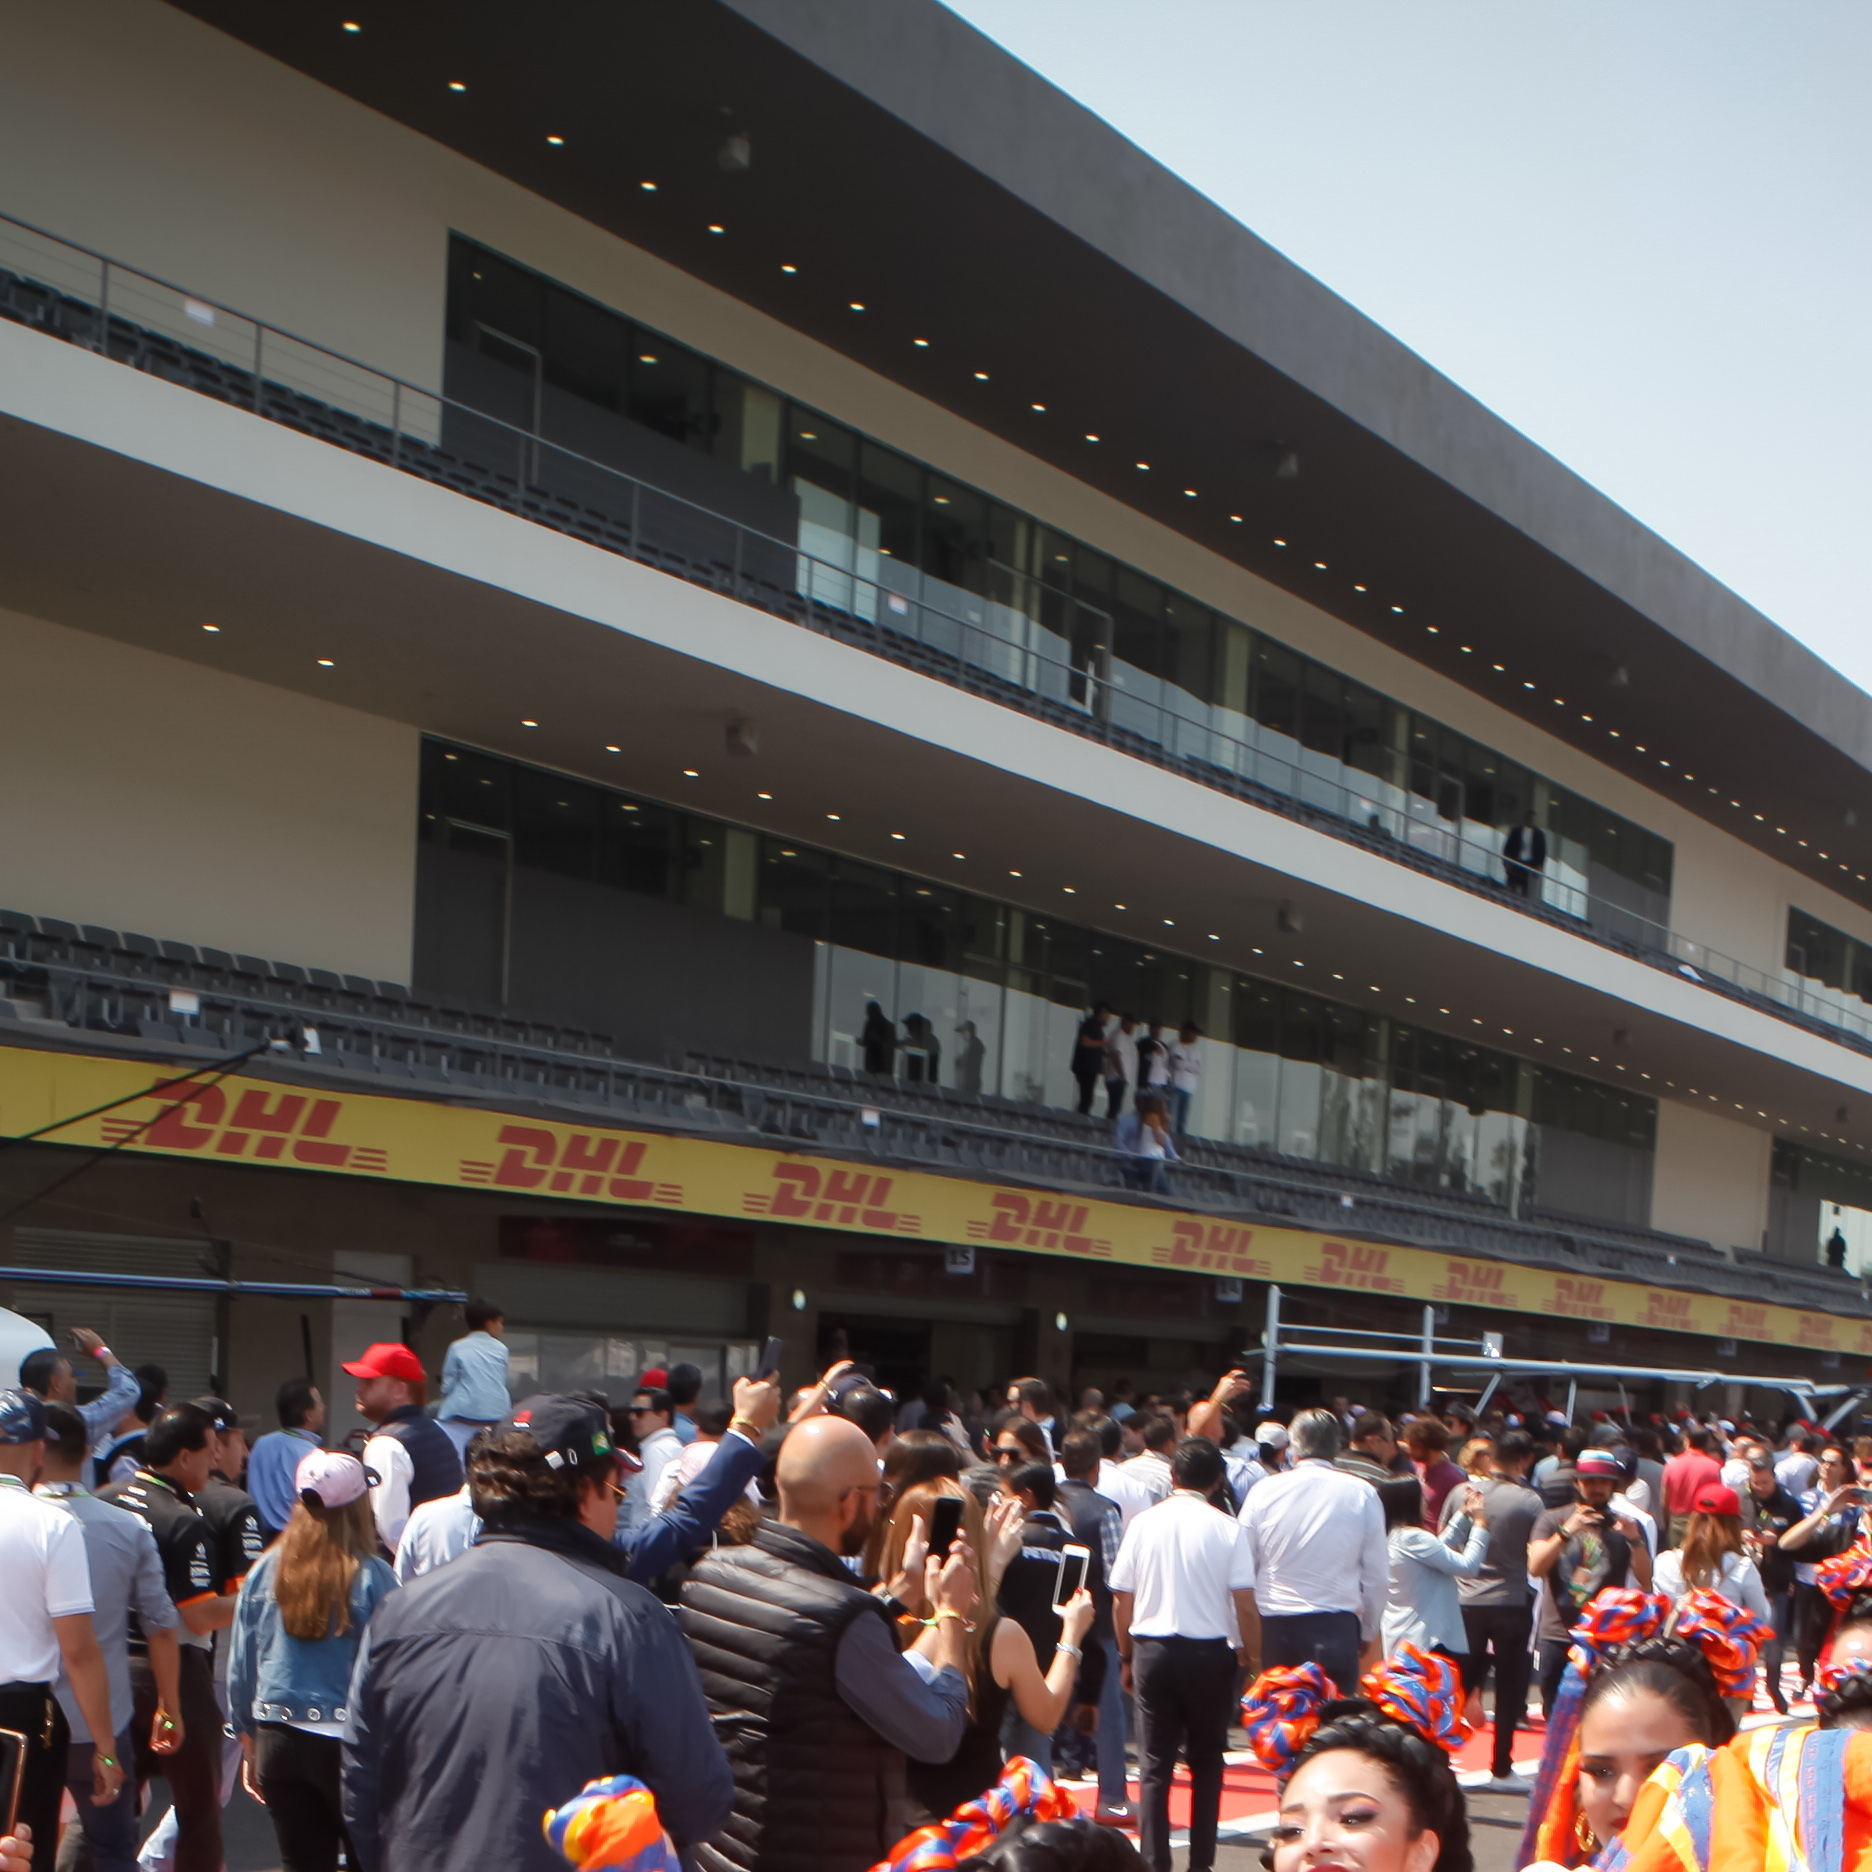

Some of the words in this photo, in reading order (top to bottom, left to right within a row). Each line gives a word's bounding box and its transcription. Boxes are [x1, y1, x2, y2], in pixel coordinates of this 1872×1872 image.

[142, 1076, 351, 1168] DHL
[493, 1125, 655, 1200] DHL
[770, 1162, 897, 1230] DHL
[988, 1193, 1092, 1252] DHL
[1171, 1219, 1256, 1273] DHL
[1319, 1241, 1391, 1291] DHL
[1446, 1262, 1506, 1304] DHL
